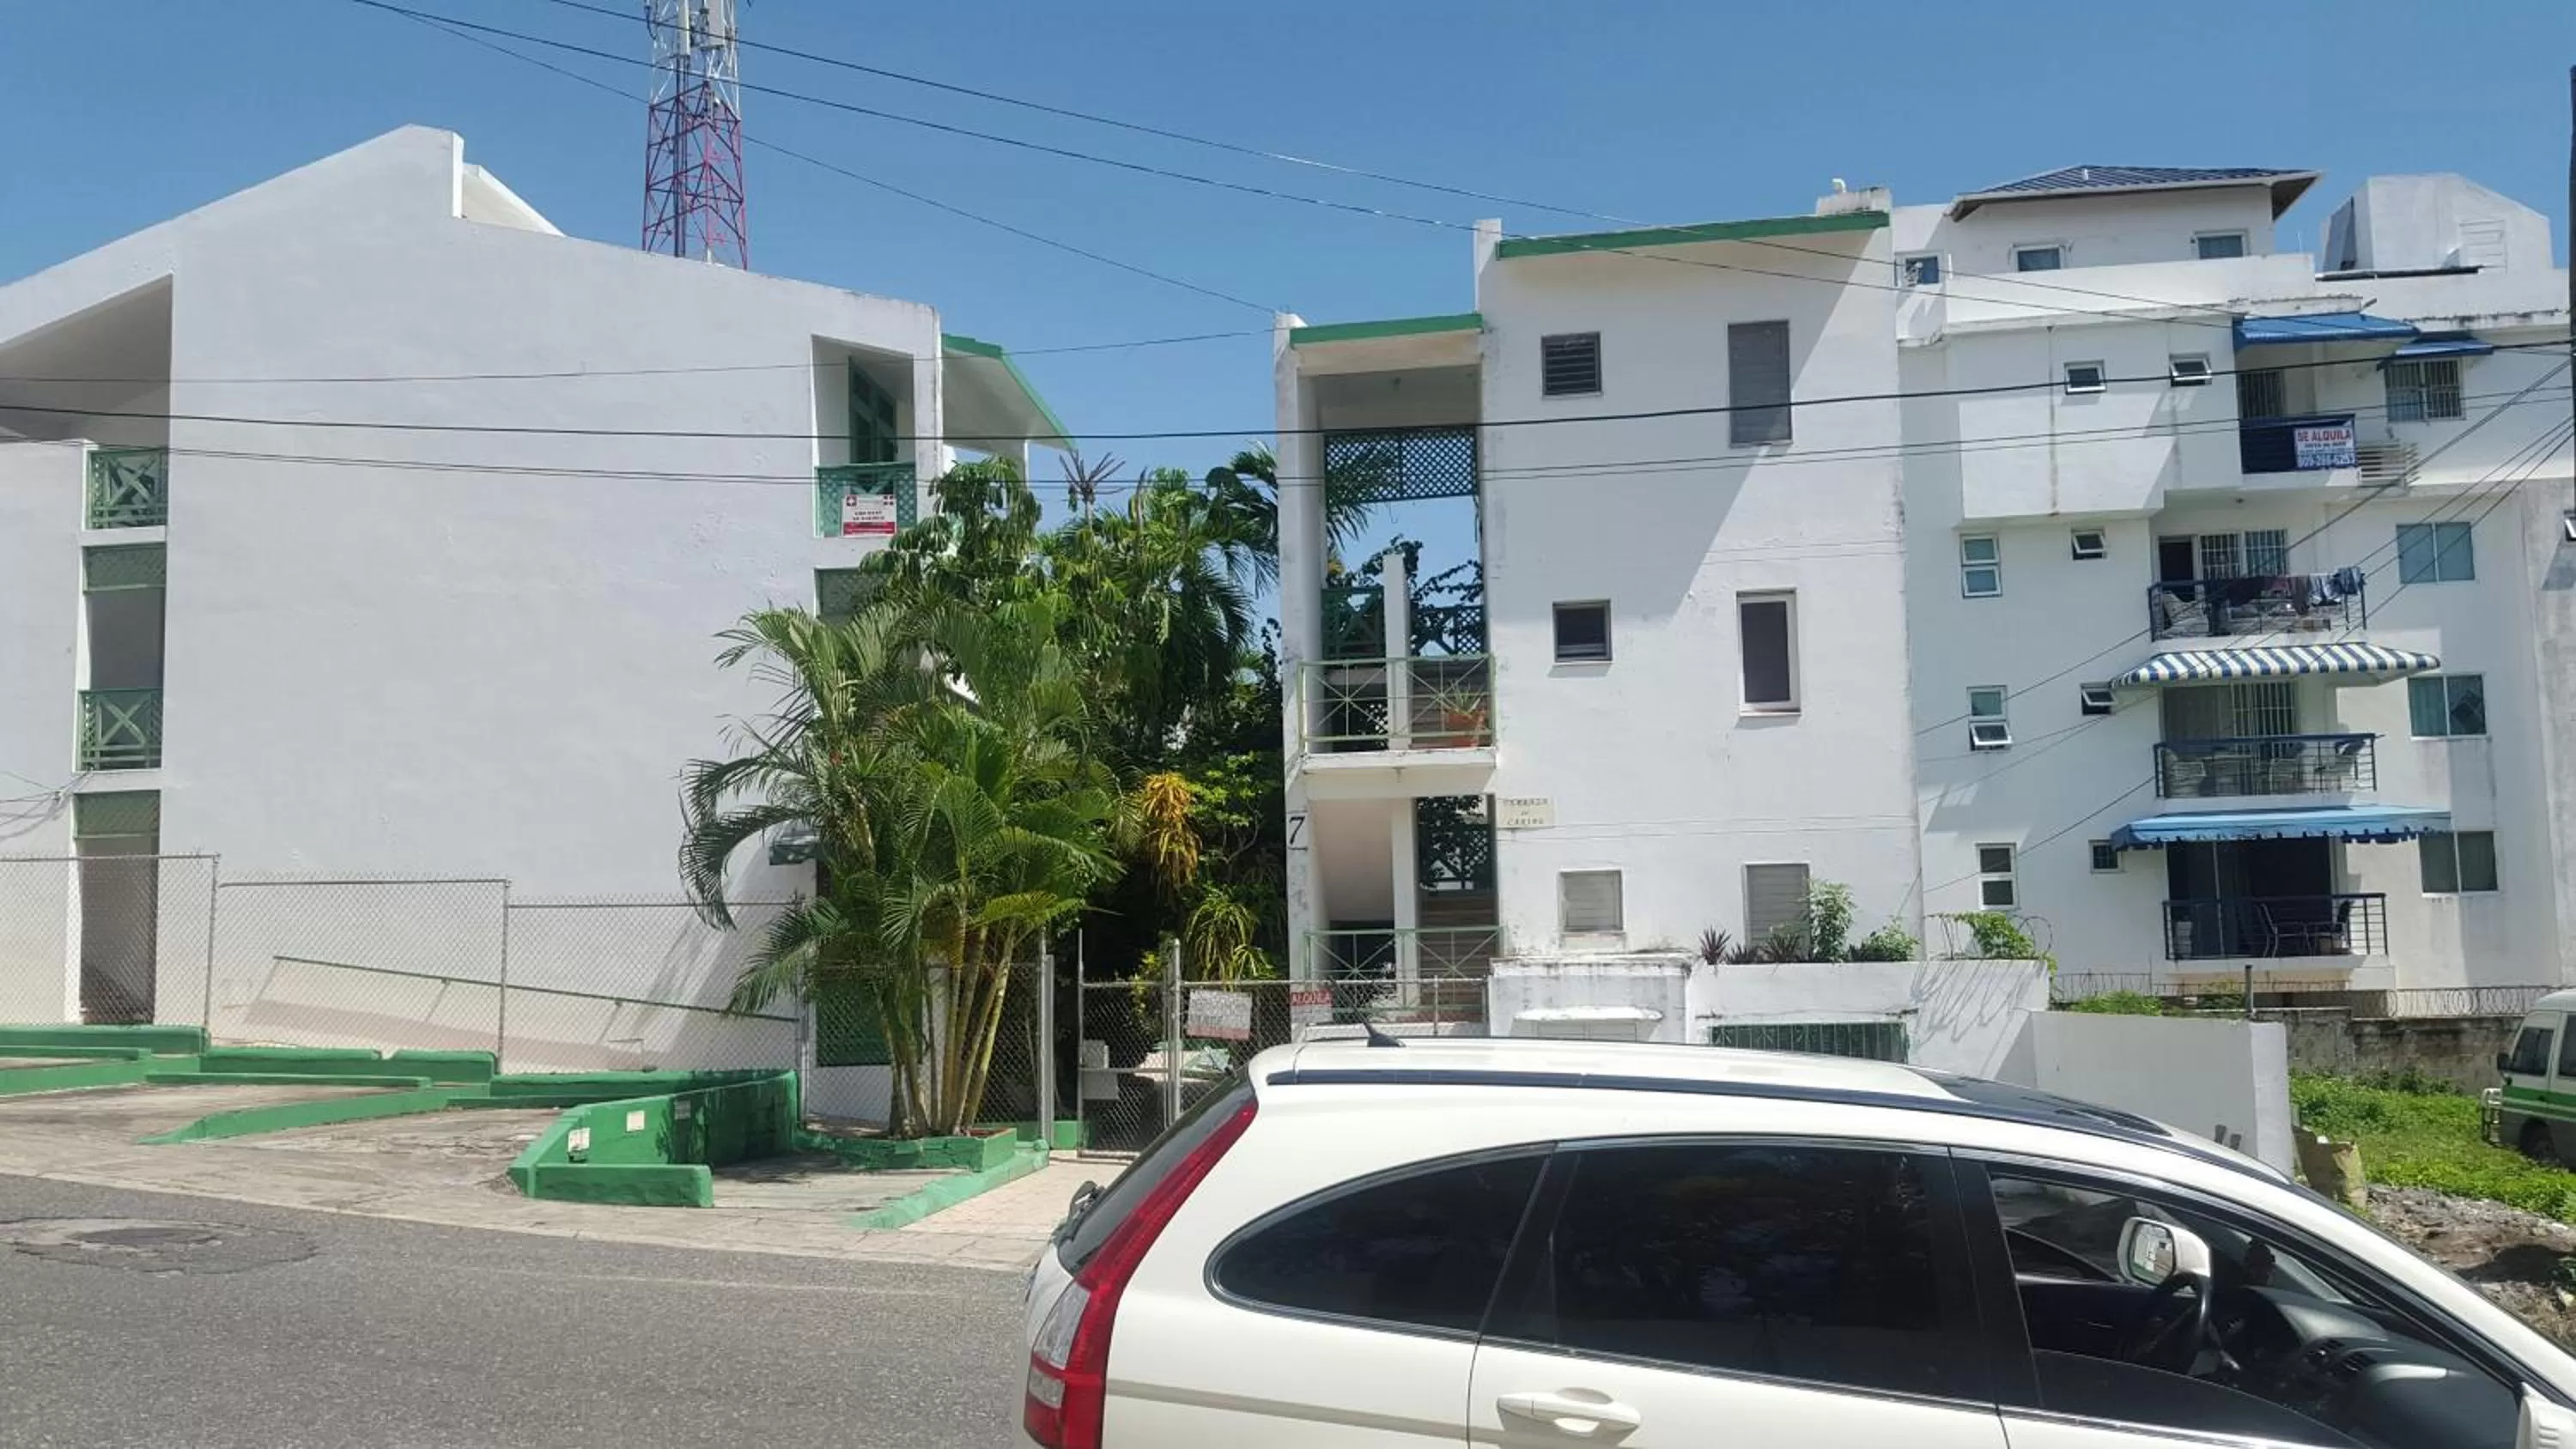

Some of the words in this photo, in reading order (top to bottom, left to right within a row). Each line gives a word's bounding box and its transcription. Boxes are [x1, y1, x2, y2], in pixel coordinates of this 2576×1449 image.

[2297, 431, 2309, 441] SE
[2312, 429, 2352, 441] ALQUILA
[1290, 816, 1306, 845] 7
